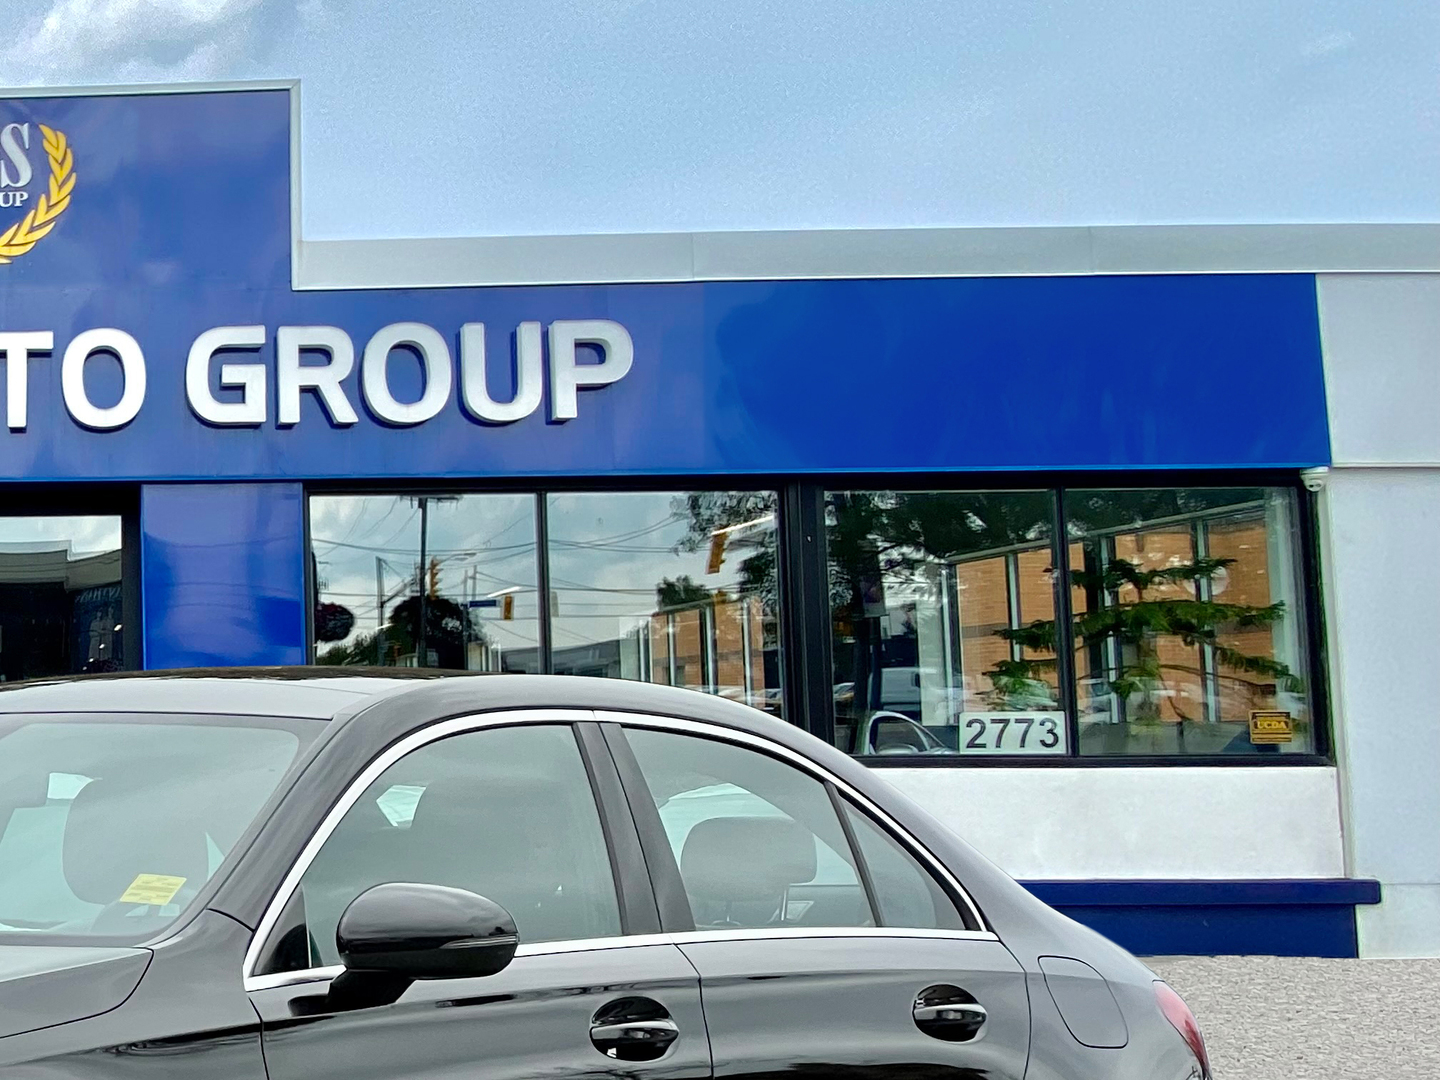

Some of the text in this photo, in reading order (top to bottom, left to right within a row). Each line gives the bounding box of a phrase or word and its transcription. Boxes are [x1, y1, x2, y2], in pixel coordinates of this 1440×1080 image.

[185, 319, 634, 427] GROUP
[965, 717, 1060, 750] 2773
[1257, 721, 1287, 729] UCDA
